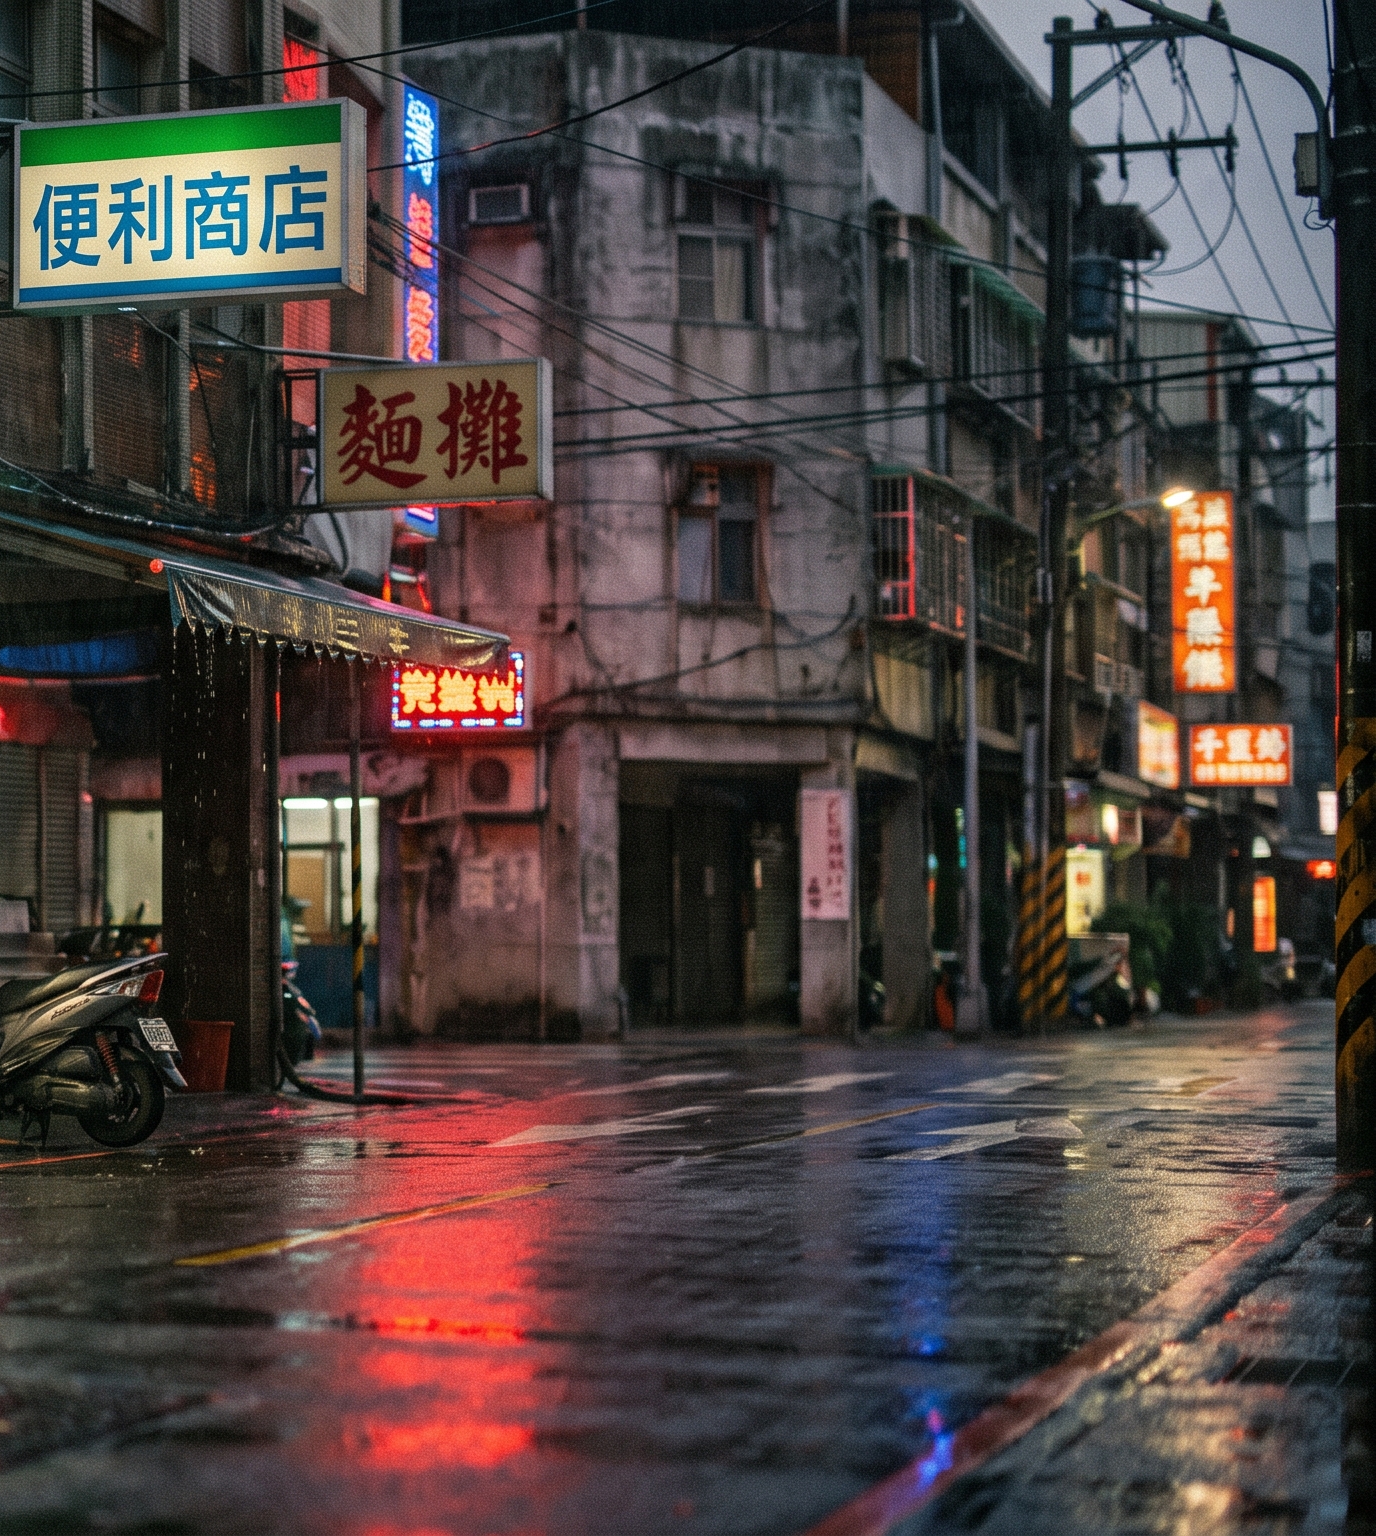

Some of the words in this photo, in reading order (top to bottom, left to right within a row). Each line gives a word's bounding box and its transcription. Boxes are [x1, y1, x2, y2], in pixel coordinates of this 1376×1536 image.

[33, 165, 328, 270] 便利商店
[337, 378, 528, 489] 麵攤
